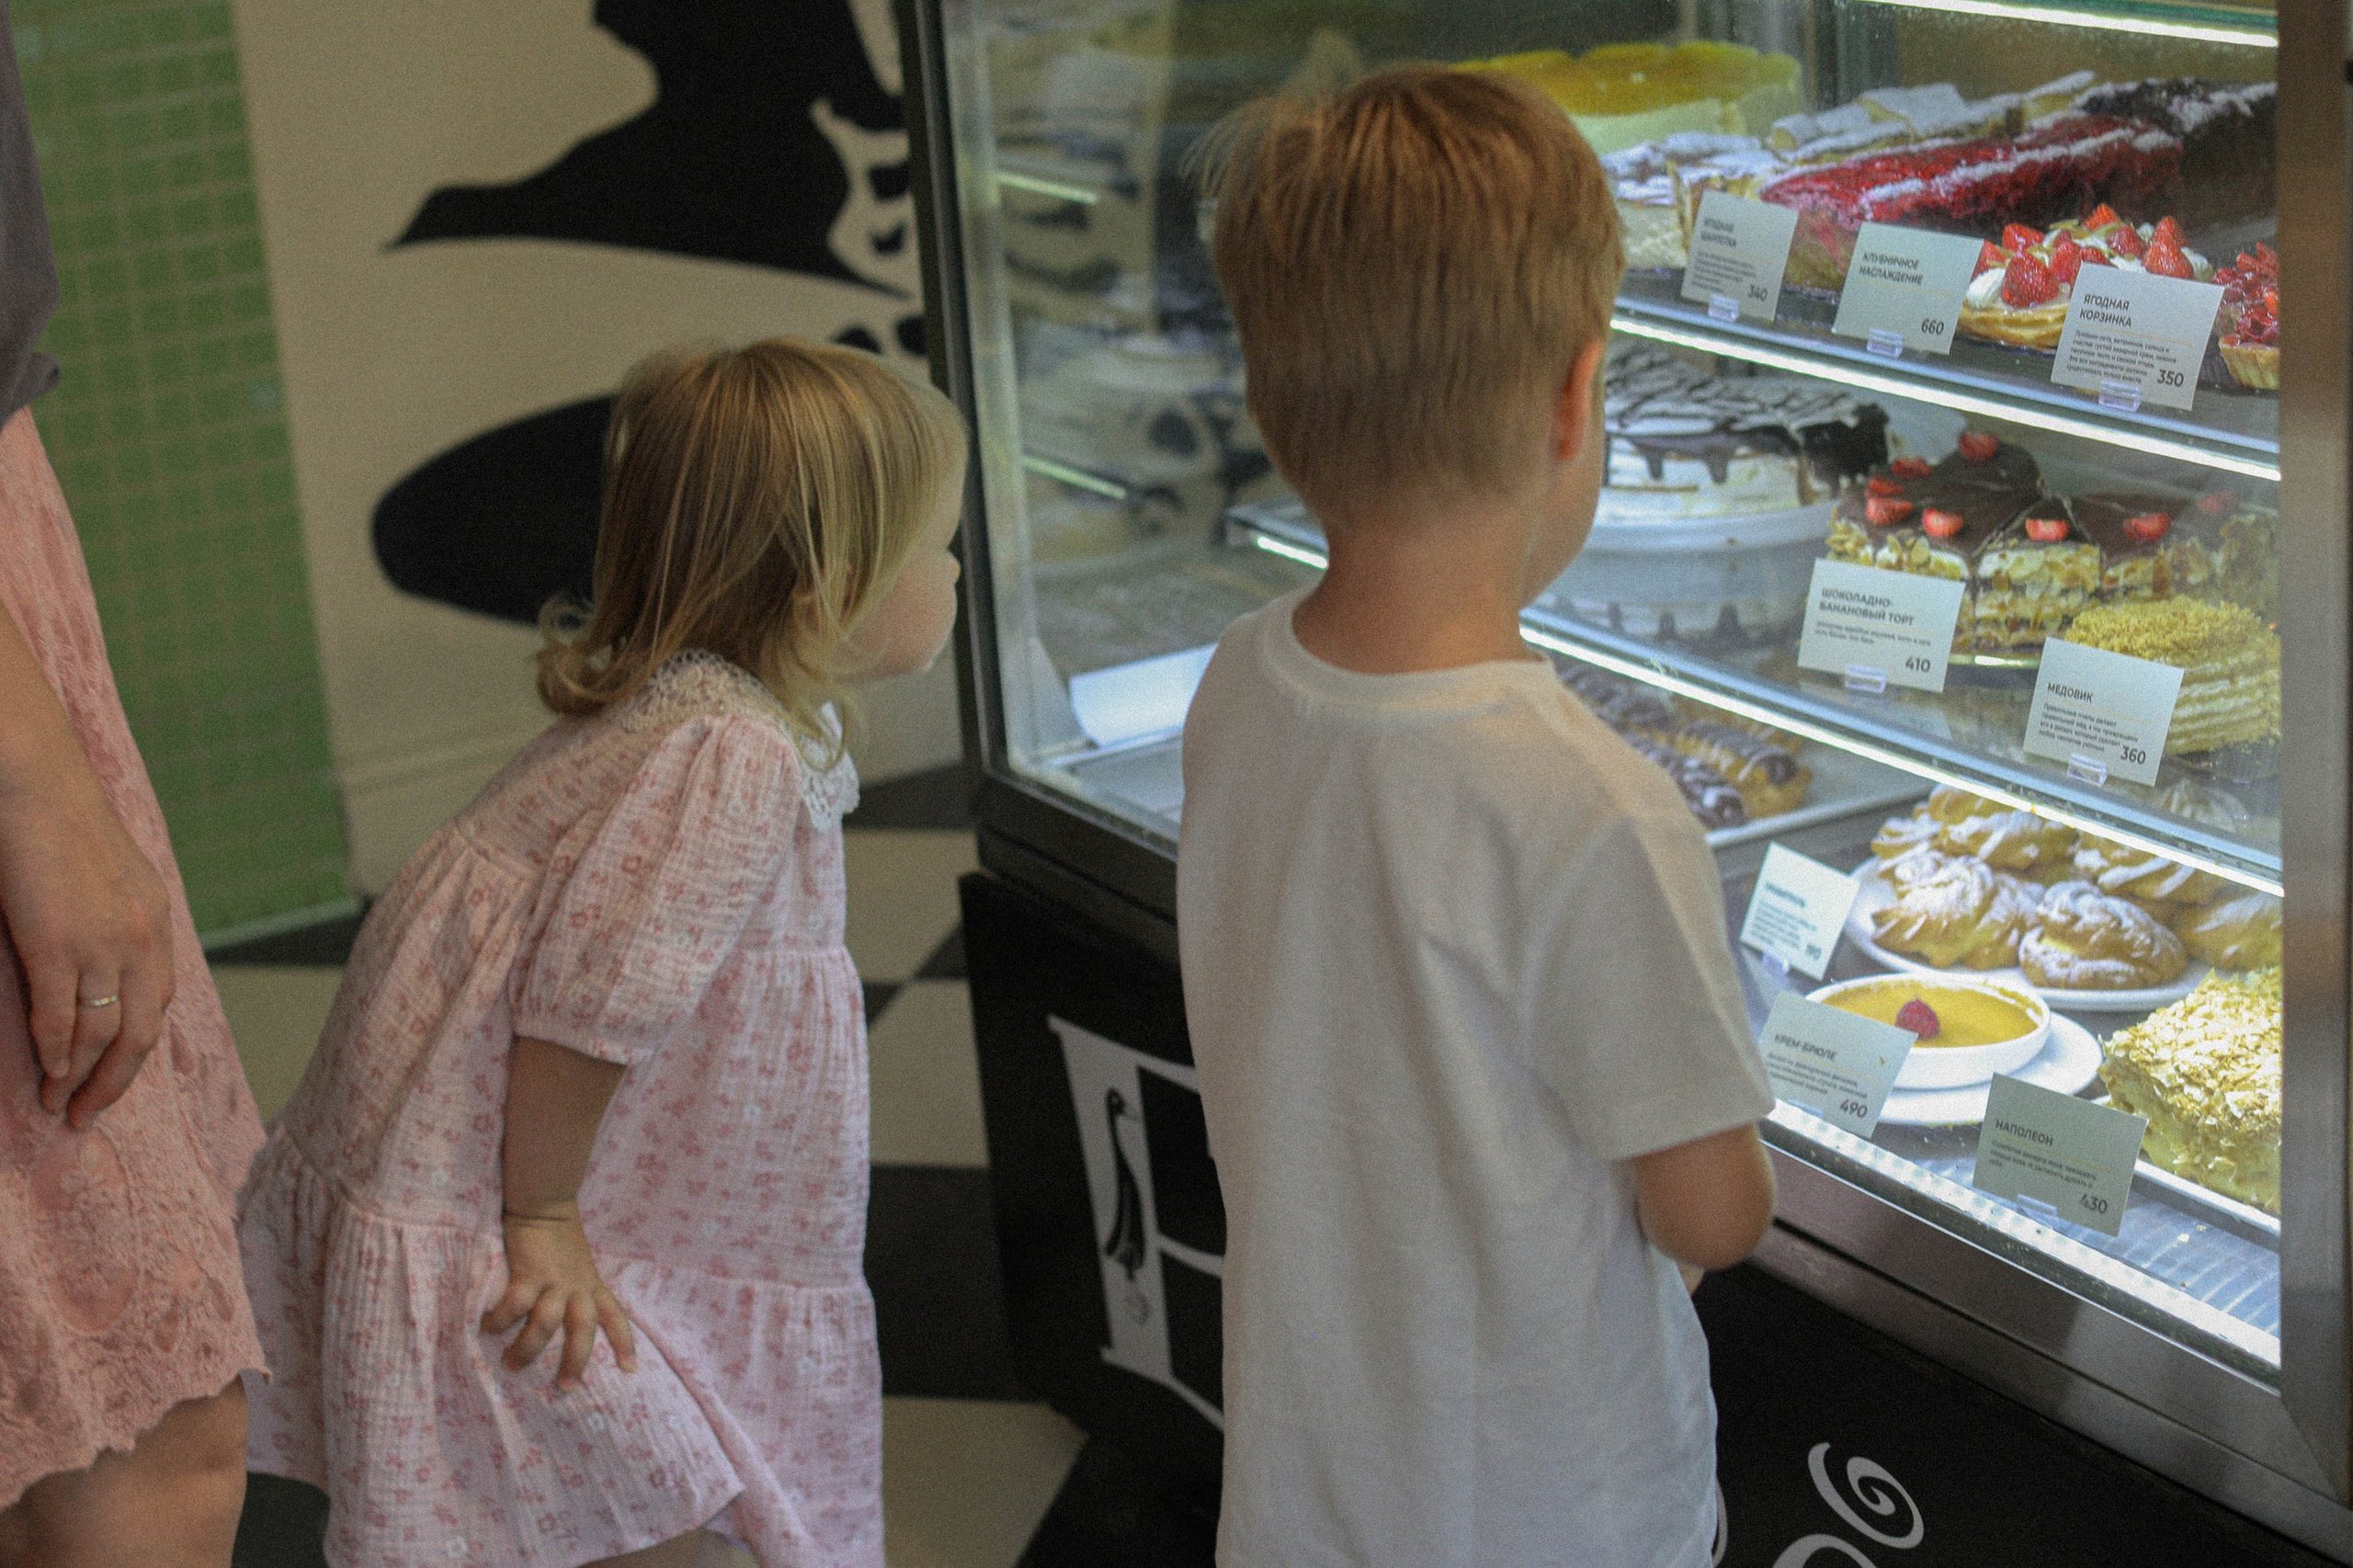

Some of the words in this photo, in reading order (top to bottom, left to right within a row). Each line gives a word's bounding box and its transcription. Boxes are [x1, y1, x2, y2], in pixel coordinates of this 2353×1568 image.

[1862, 252, 1919, 268] КЛУБНИЧНОЕ
[1859, 266, 1923, 284] НАСЛАЖДЕНИЕ
[2084, 294, 2129, 311] ЯГОДНАЯ
[1920, 318, 1945, 334] 660
[2079, 309, 2131, 326] КОРЗИНКА
[2156, 369, 2184, 387] 350
[1820, 600, 1885, 619] БАНАНОВЫЙ
[1888, 612, 1914, 625] ТОРТ
[1905, 656, 1930, 672] 410
[2047, 683, 2092, 702] МЕДОВИК
[2120, 745, 2146, 764] 360
[1839, 1096, 1868, 1119] 490
[1995, 1119, 2052, 1145] НАПОЛЕОН
[2078, 1192, 2108, 1214] 430
